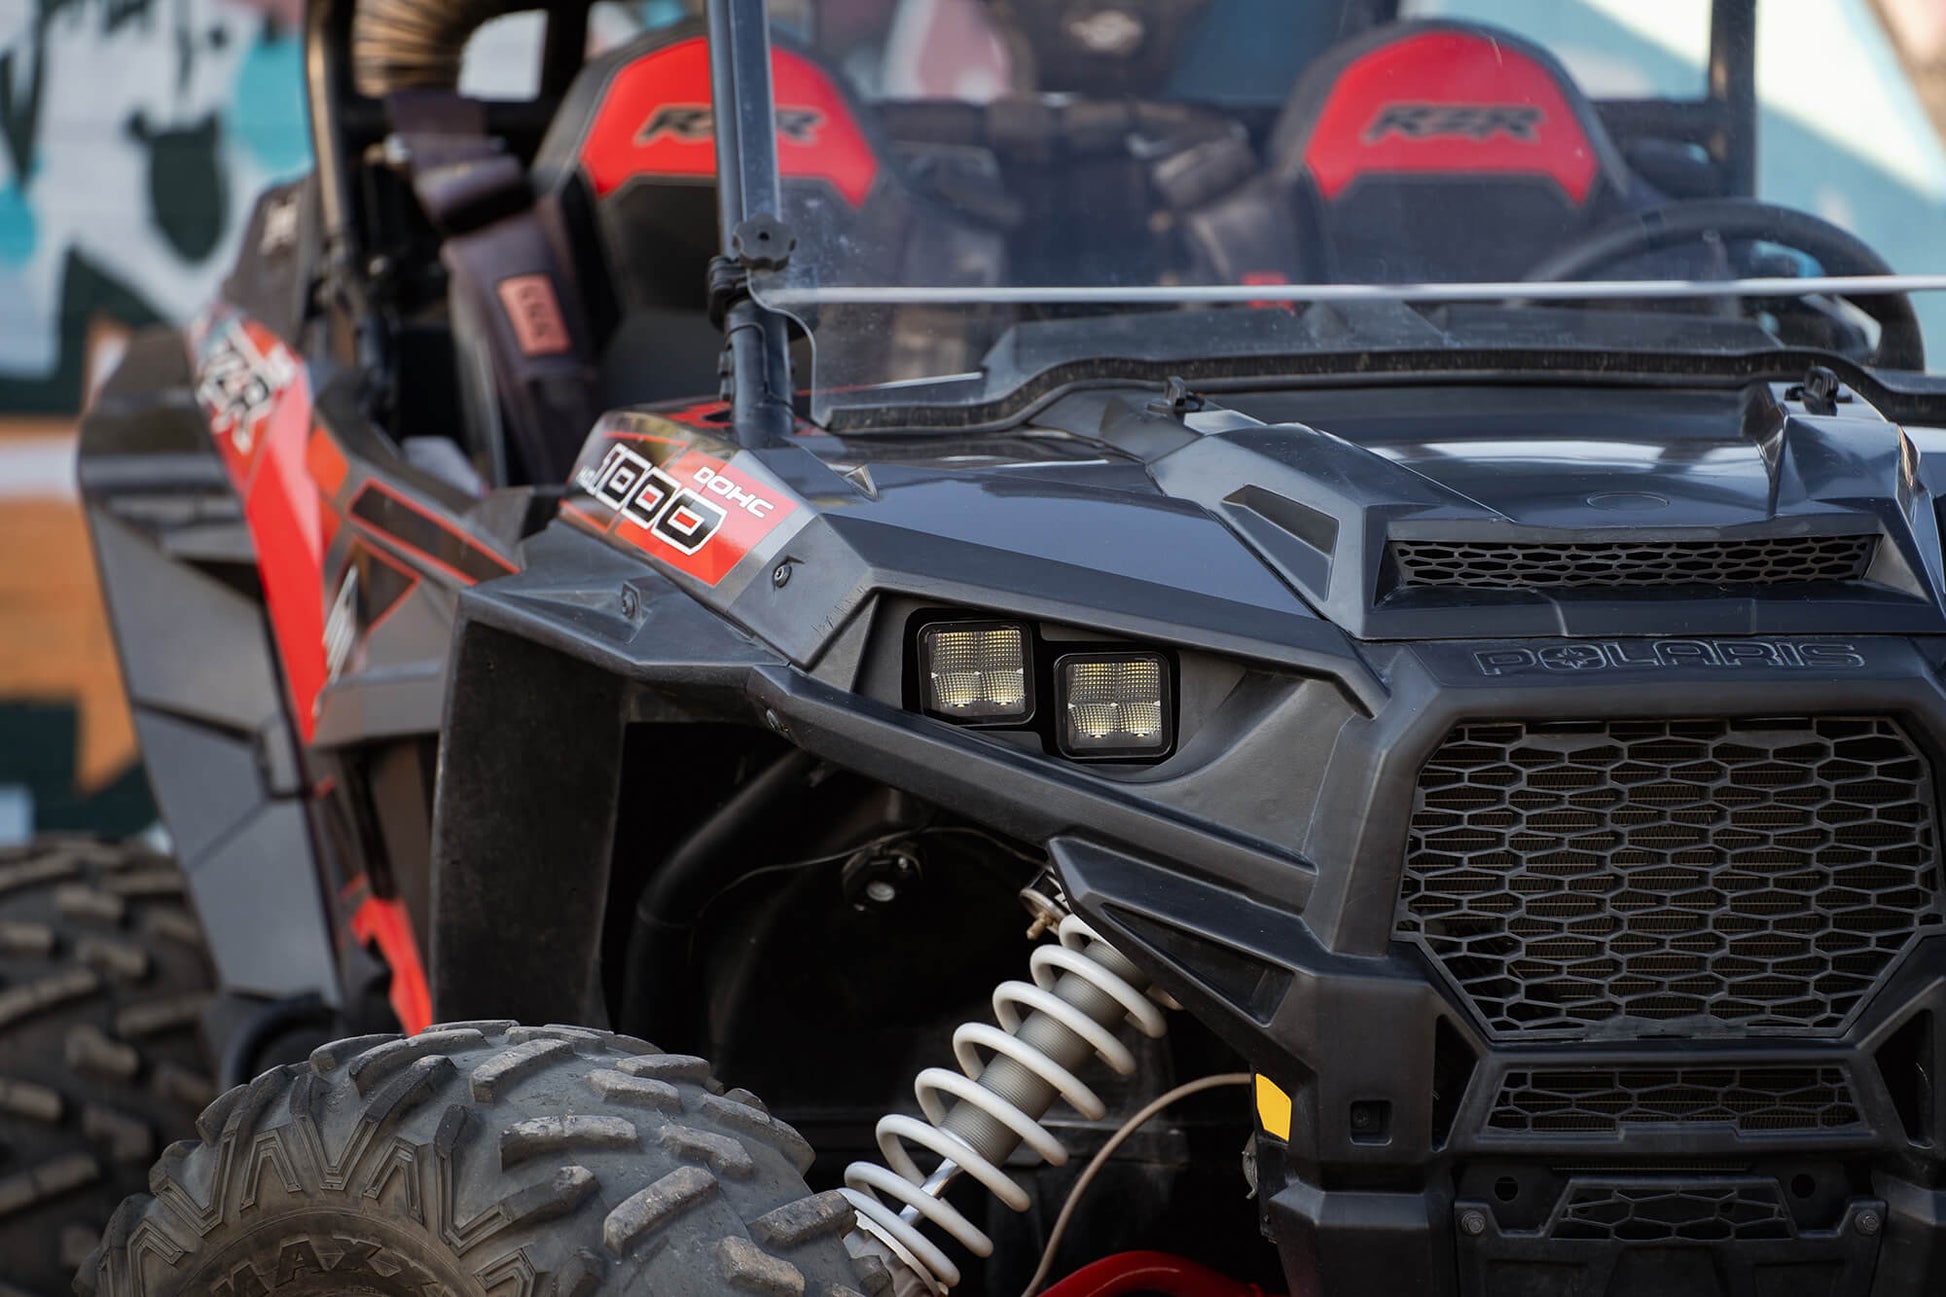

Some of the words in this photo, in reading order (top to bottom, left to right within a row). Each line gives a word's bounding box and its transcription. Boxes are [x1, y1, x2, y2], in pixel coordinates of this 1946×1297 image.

[634, 104, 825, 146] RR
[1362, 101, 1549, 147] RZR
[586, 442, 728, 556] 1000
[693, 466, 775, 519] DOHC
[1473, 638, 1866, 676] POLARIS
